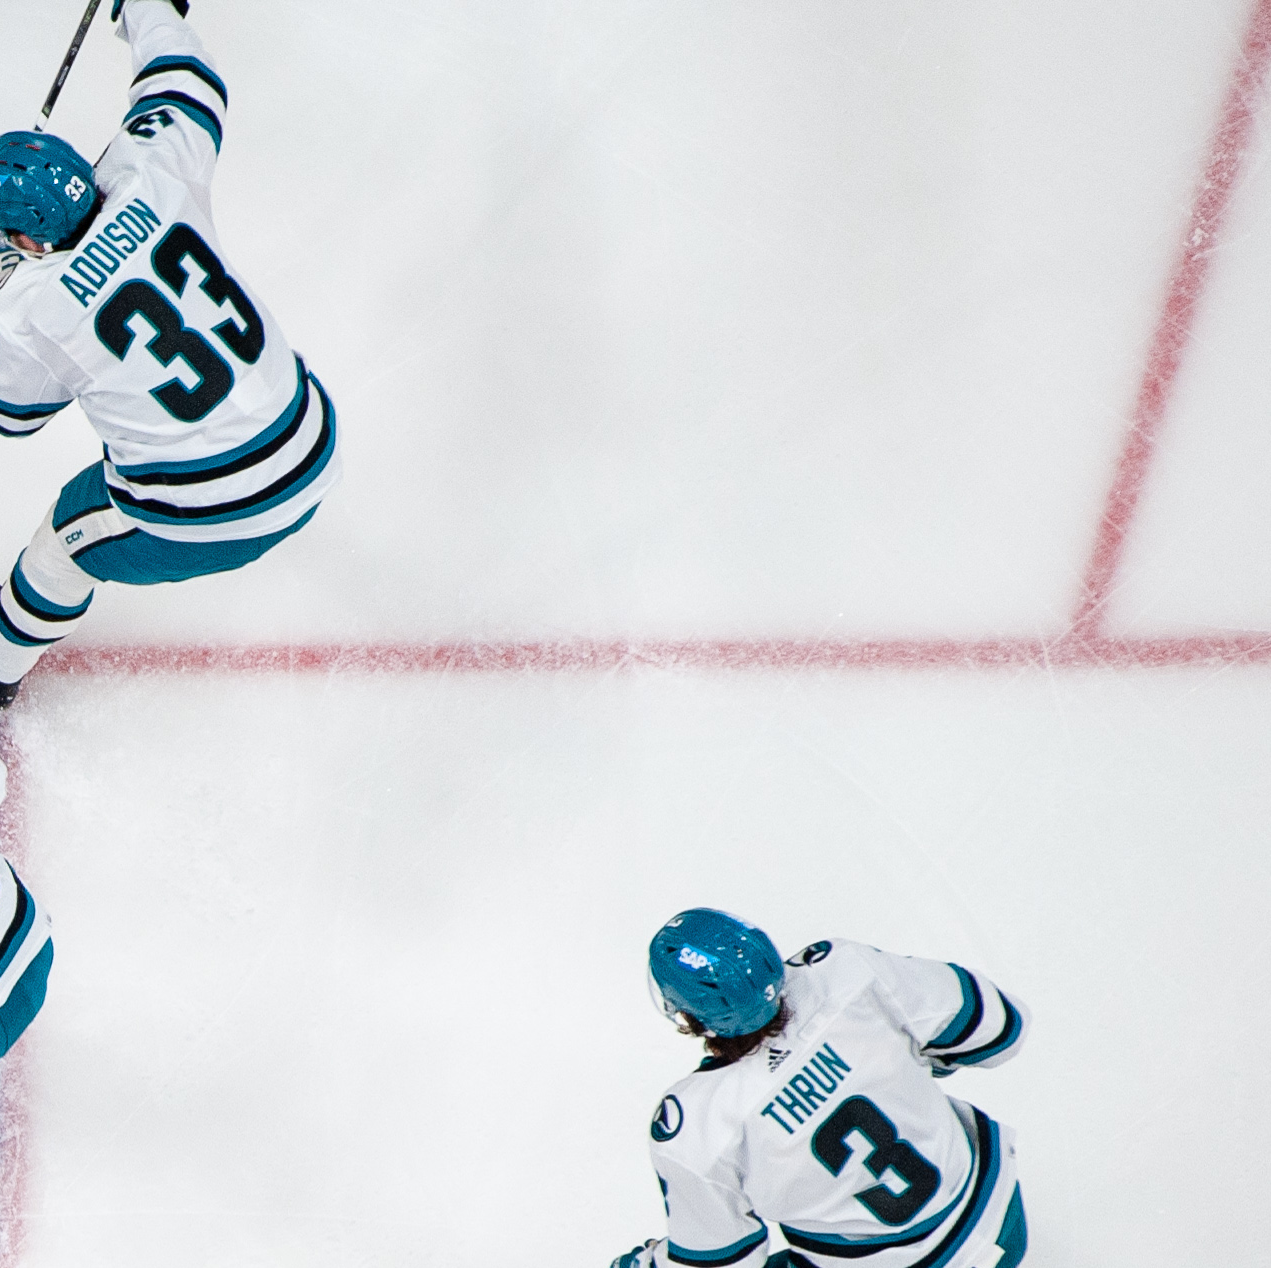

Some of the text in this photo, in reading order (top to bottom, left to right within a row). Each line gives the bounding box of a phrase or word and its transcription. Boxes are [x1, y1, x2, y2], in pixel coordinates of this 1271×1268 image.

[64, 175, 86, 202] 33
[60, 198, 162, 308] ADDISON
[94, 222, 265, 423] 33
[65, 529, 84, 545] CCM
[678, 947, 709, 970] SAP
[761, 1042, 852, 1135] THRUN
[810, 1094, 942, 1227] 3
